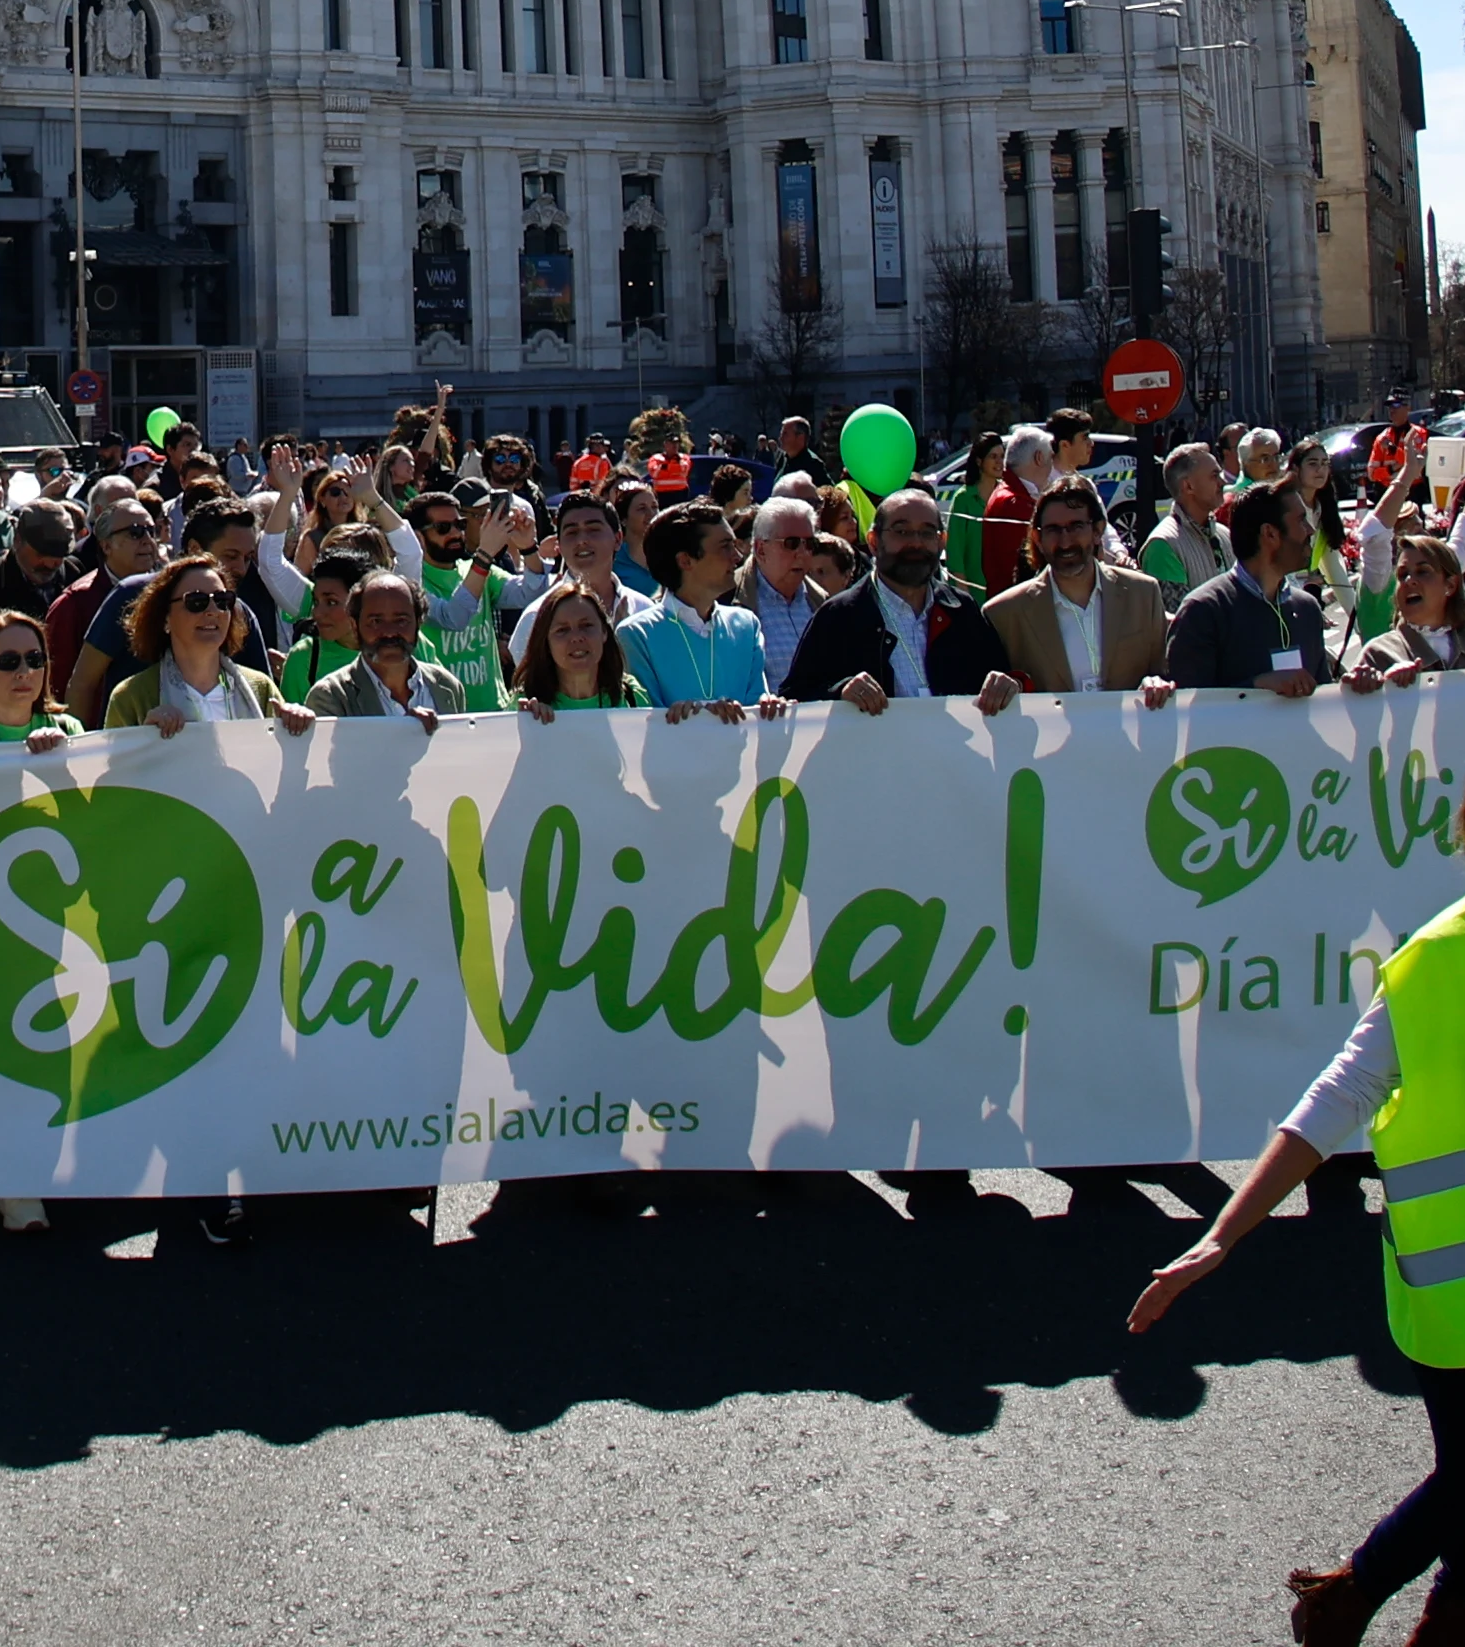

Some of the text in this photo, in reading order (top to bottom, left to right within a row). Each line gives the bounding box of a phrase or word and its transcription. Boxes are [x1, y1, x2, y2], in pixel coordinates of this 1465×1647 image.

[441, 625, 477, 656] VIVE
[450, 656, 488, 686] VIDA
[1171, 766, 1351, 874] Sí a
[1297, 803, 1358, 863] la
[280, 767, 1045, 1055] la Vida!
[311, 838, 405, 916] a
[1148, 936, 1280, 1015] Día
[271, 1090, 700, 1154] www.sialavida.es
